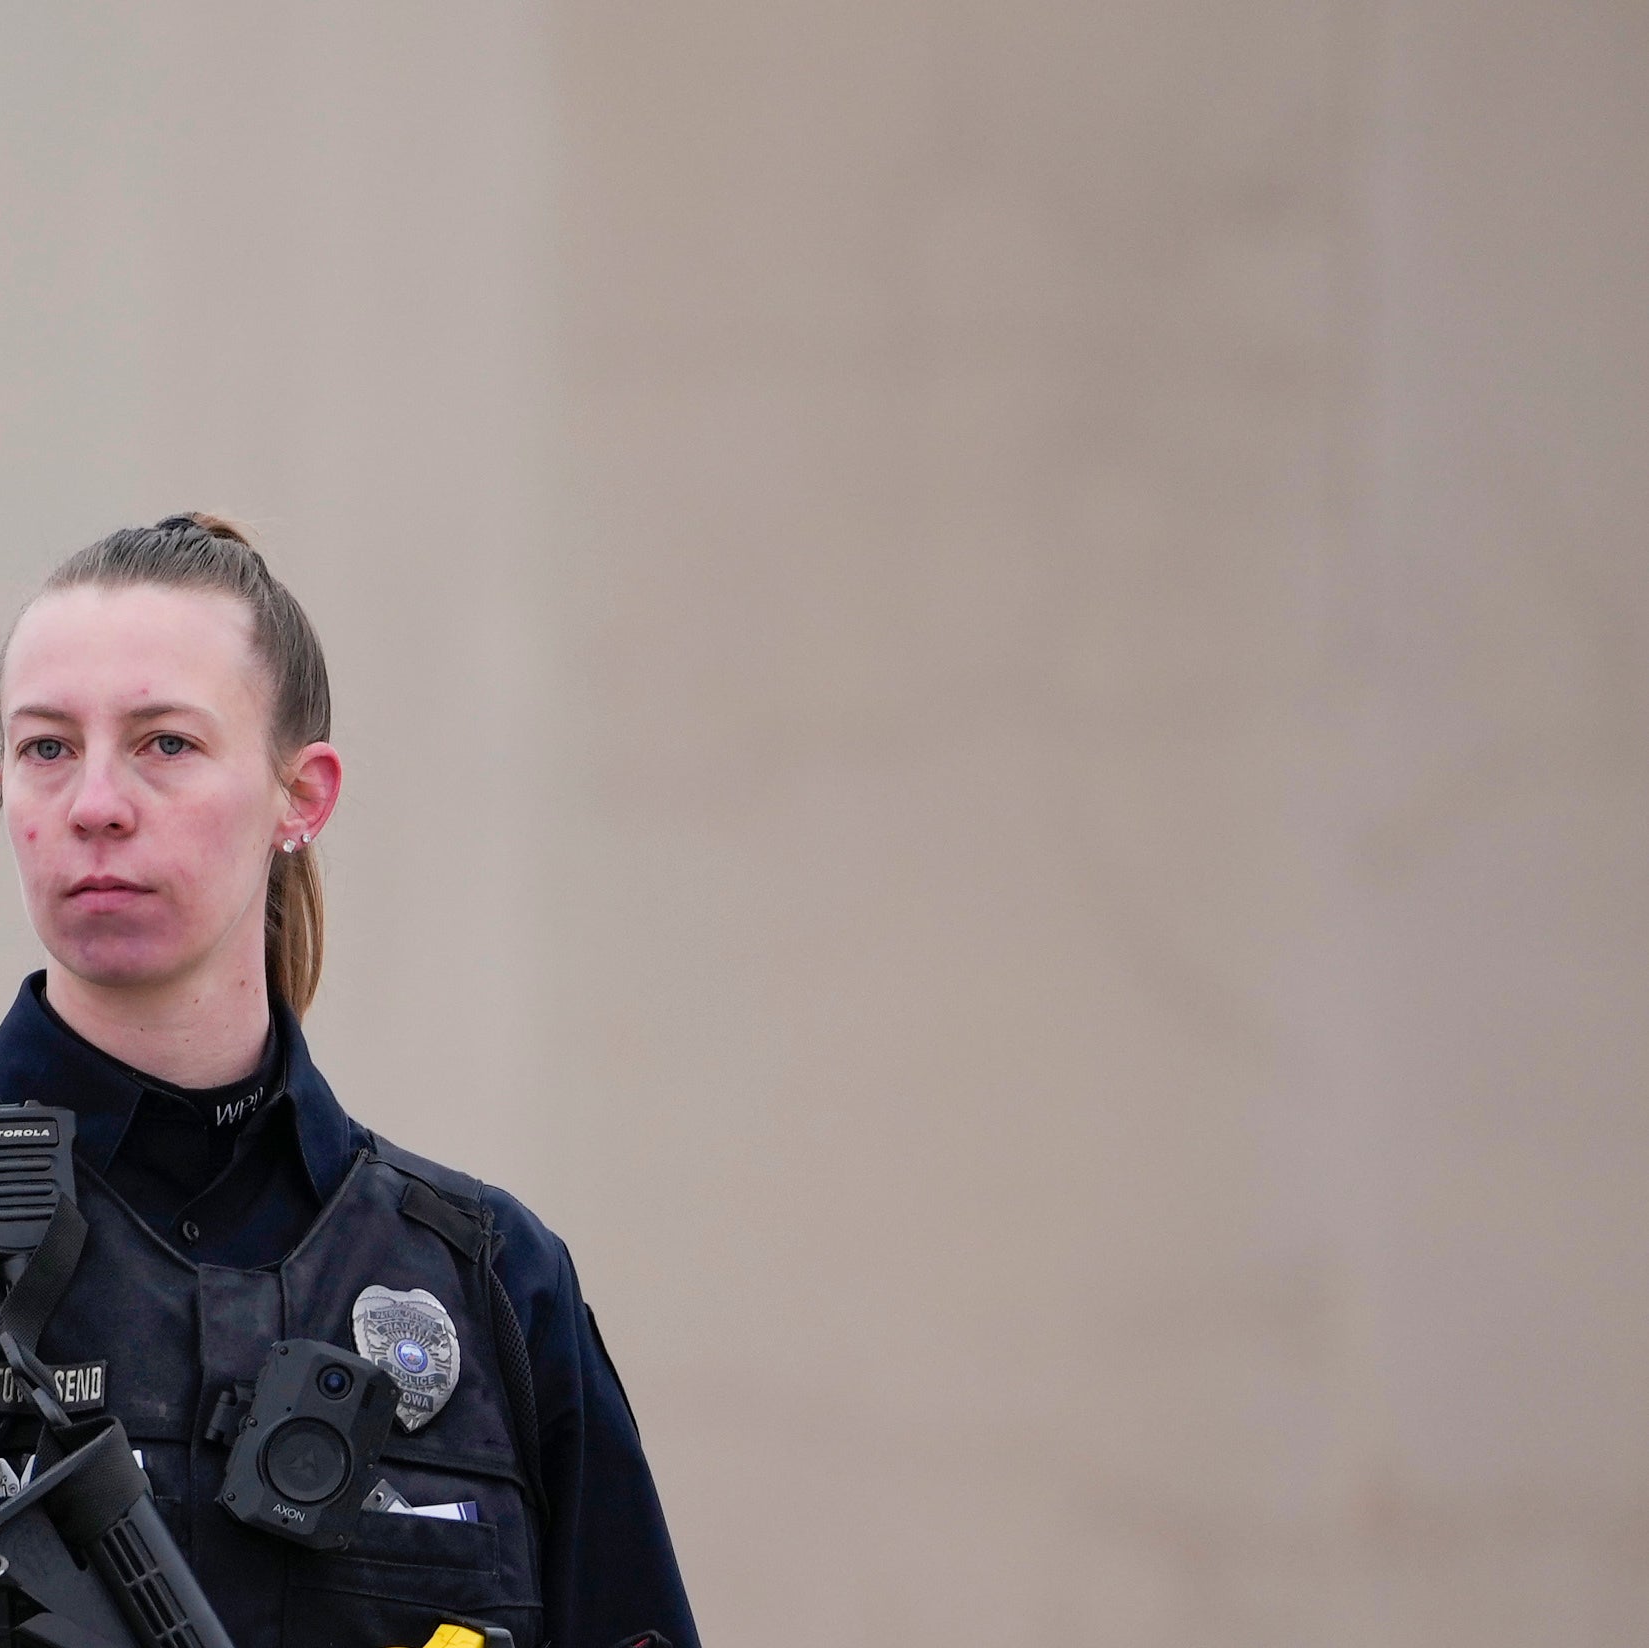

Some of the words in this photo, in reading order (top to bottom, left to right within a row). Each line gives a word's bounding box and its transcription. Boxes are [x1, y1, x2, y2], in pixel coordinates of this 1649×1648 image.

[391, 1366, 436, 1386] POLICE
[400, 1391, 430, 1408] OWA
[272, 1503, 306, 1523] AXON
